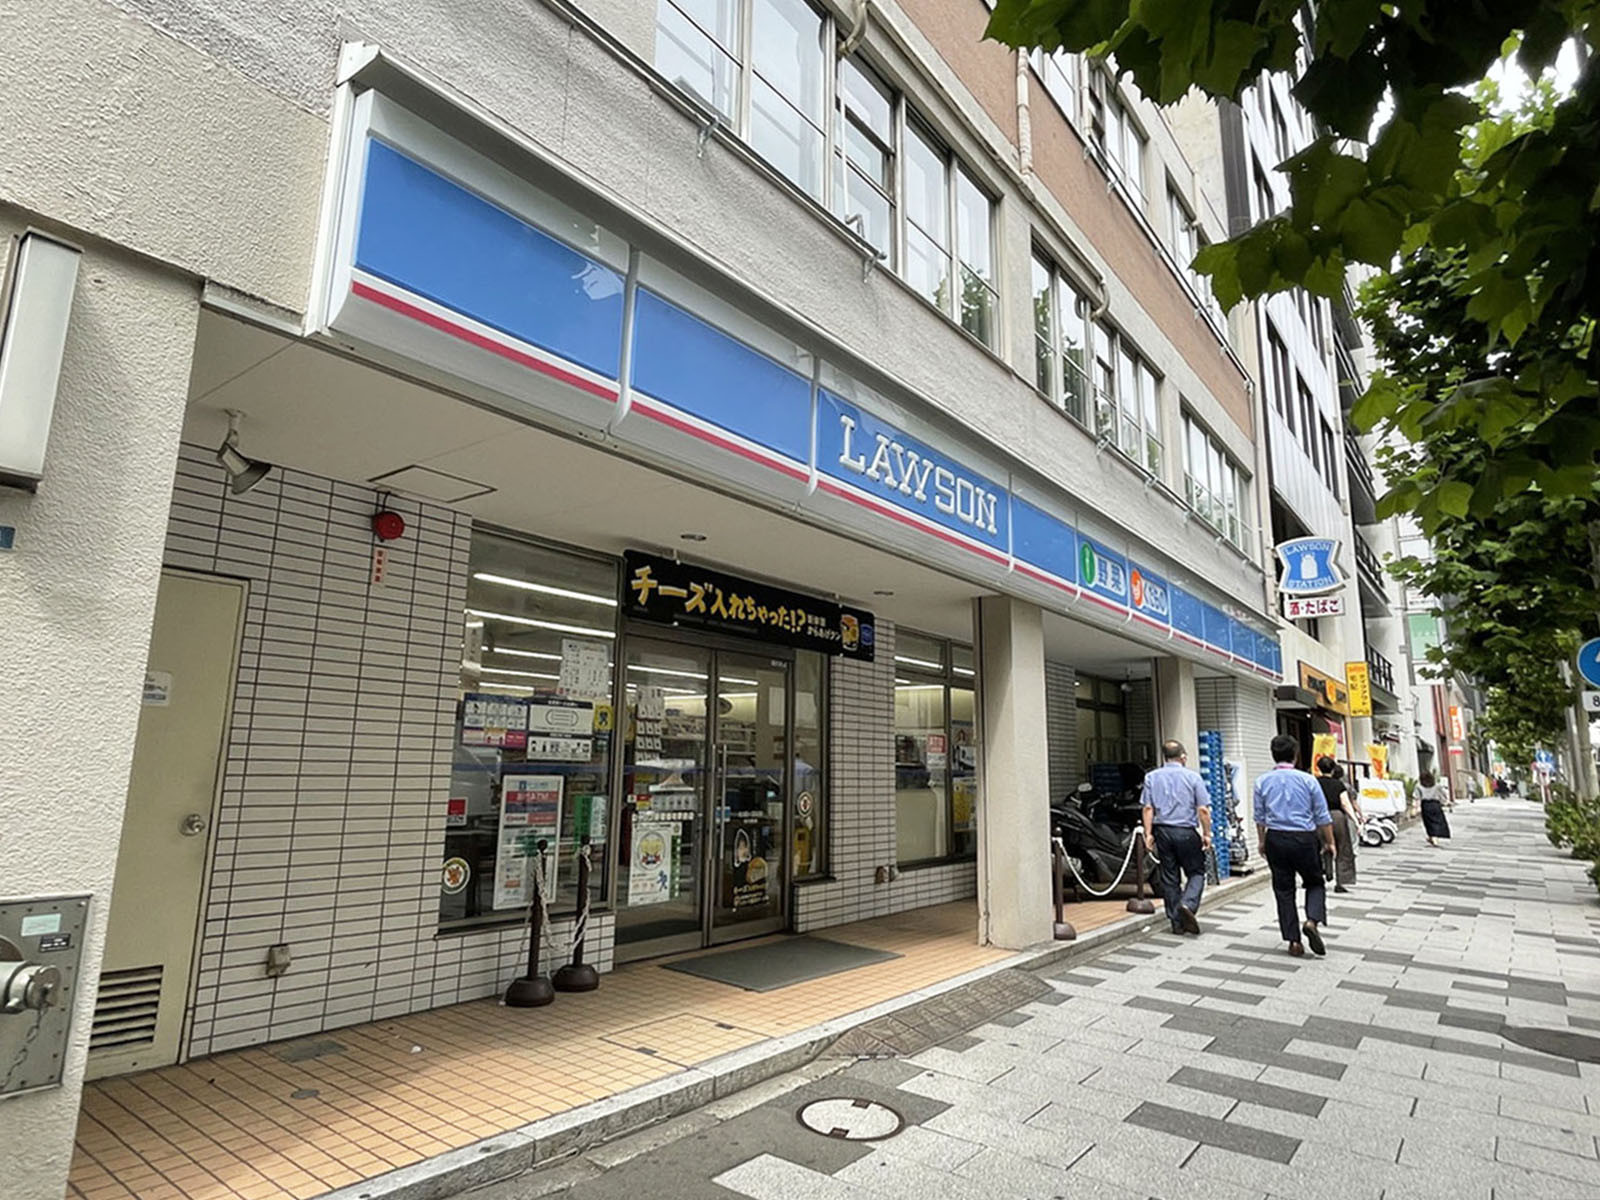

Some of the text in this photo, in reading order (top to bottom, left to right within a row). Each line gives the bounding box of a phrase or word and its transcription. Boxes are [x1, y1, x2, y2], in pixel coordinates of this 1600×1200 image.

[840, 415, 998, 534] LAWSON
[1285, 542, 1331, 555] LAWSON
[1287, 576, 1333, 589] STATION
